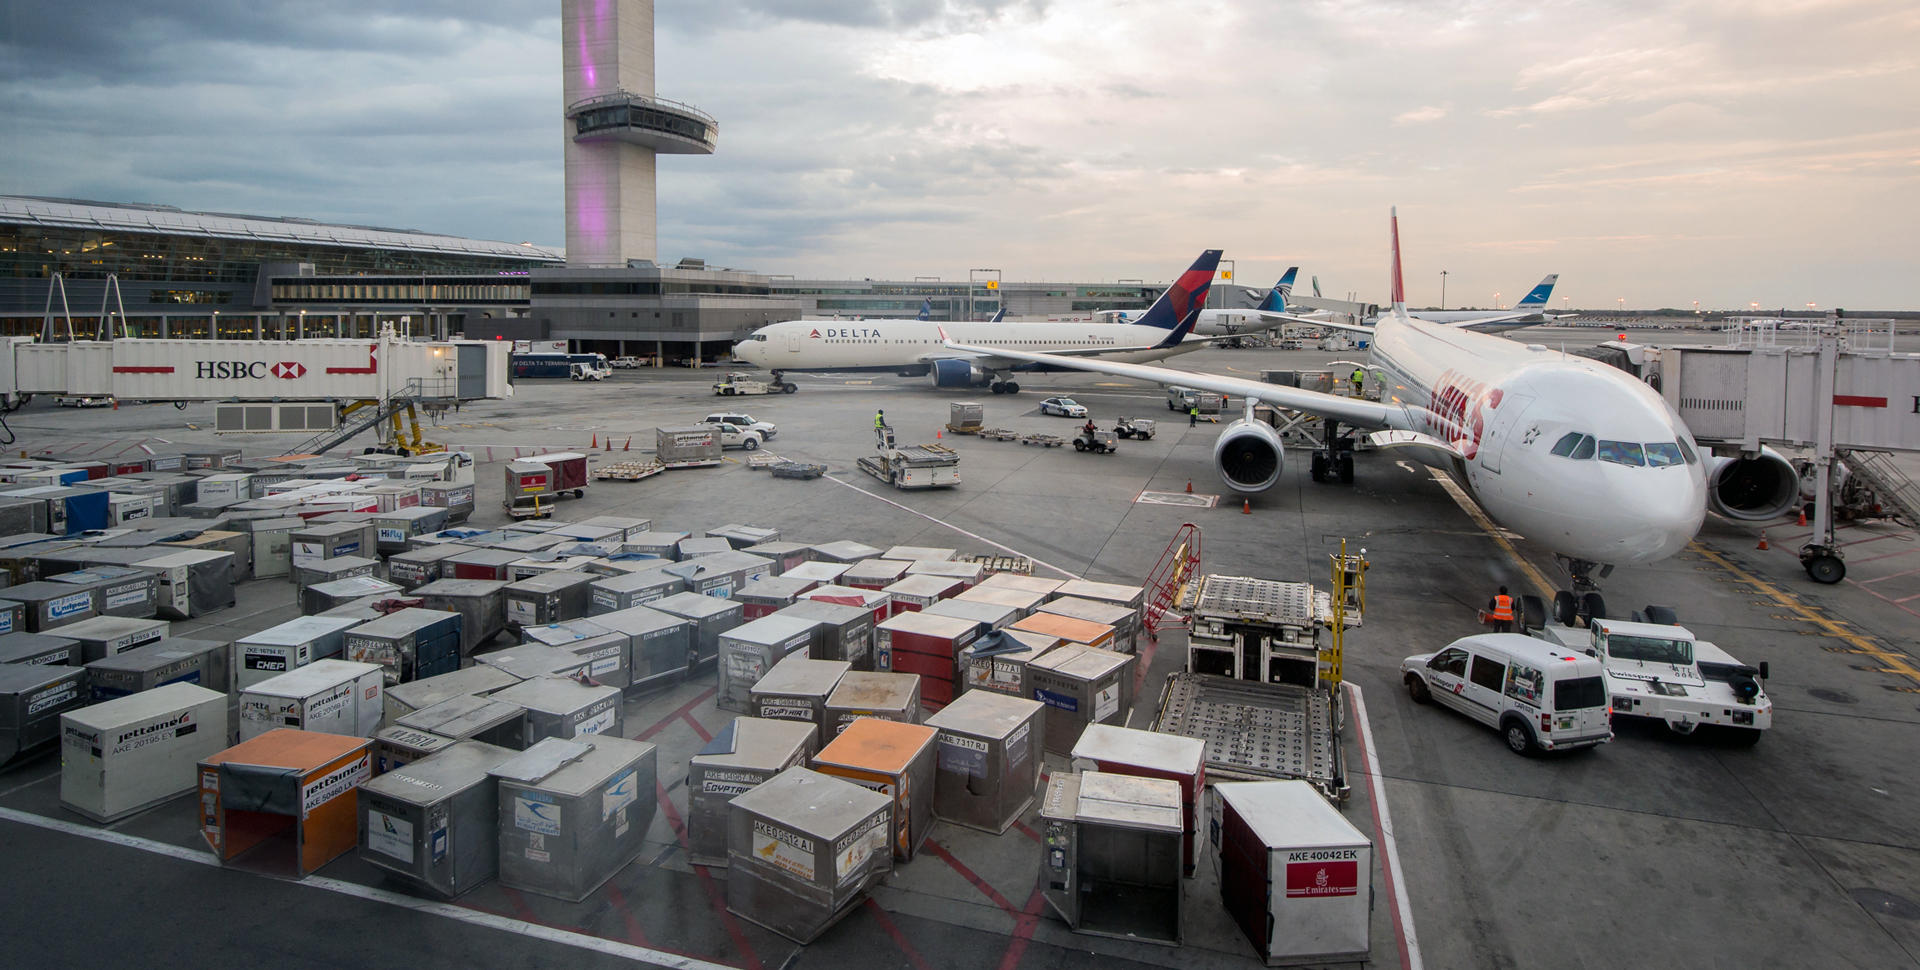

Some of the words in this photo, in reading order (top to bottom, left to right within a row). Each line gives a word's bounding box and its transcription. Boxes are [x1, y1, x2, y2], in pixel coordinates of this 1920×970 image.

[827, 329, 881, 338] DELTA
[195, 361, 266, 379] HSBC
[130, 511, 147, 519] CHEP
[108, 586, 119, 595] AKE
[117, 639, 130, 647] ZKE
[151, 629, 160, 637] R7
[256, 661, 285, 670] CHEP
[309, 686, 350, 712] jettainer
[309, 711, 322, 721] AKE
[342, 698, 350, 707] EY
[762, 707, 803, 717] EGYPTAIR
[1515, 701, 1525, 711] CAR
[1525, 705, 1534, 714] 029
[241, 711, 254, 720] AKE
[117, 711, 190, 744] jettainer
[583, 723, 598, 734] Arik
[64, 736, 72, 746] AKE
[65, 725, 98, 744] jettainer
[112, 744, 131, 756] AKE
[134, 736, 160, 749] 20195
[162, 730, 174, 741] EY
[939, 734, 954, 744] AKE
[956, 738, 974, 747] 7317
[976, 743, 986, 751] RJ
[305, 757, 368, 799] jettainer
[705, 771, 723, 779] AKE
[724, 772, 747, 782] 04967
[749, 774, 762, 783] MS
[305, 796, 321, 811] AKE
[322, 786, 343, 802] 50460
[344, 781, 353, 792] LX
[800, 842, 813, 852] AI
[1289, 852, 1308, 862] AKE
[1310, 851, 1342, 860] 40042
[1343, 849, 1357, 859] EK
[1305, 885, 1340, 894] Emirates
